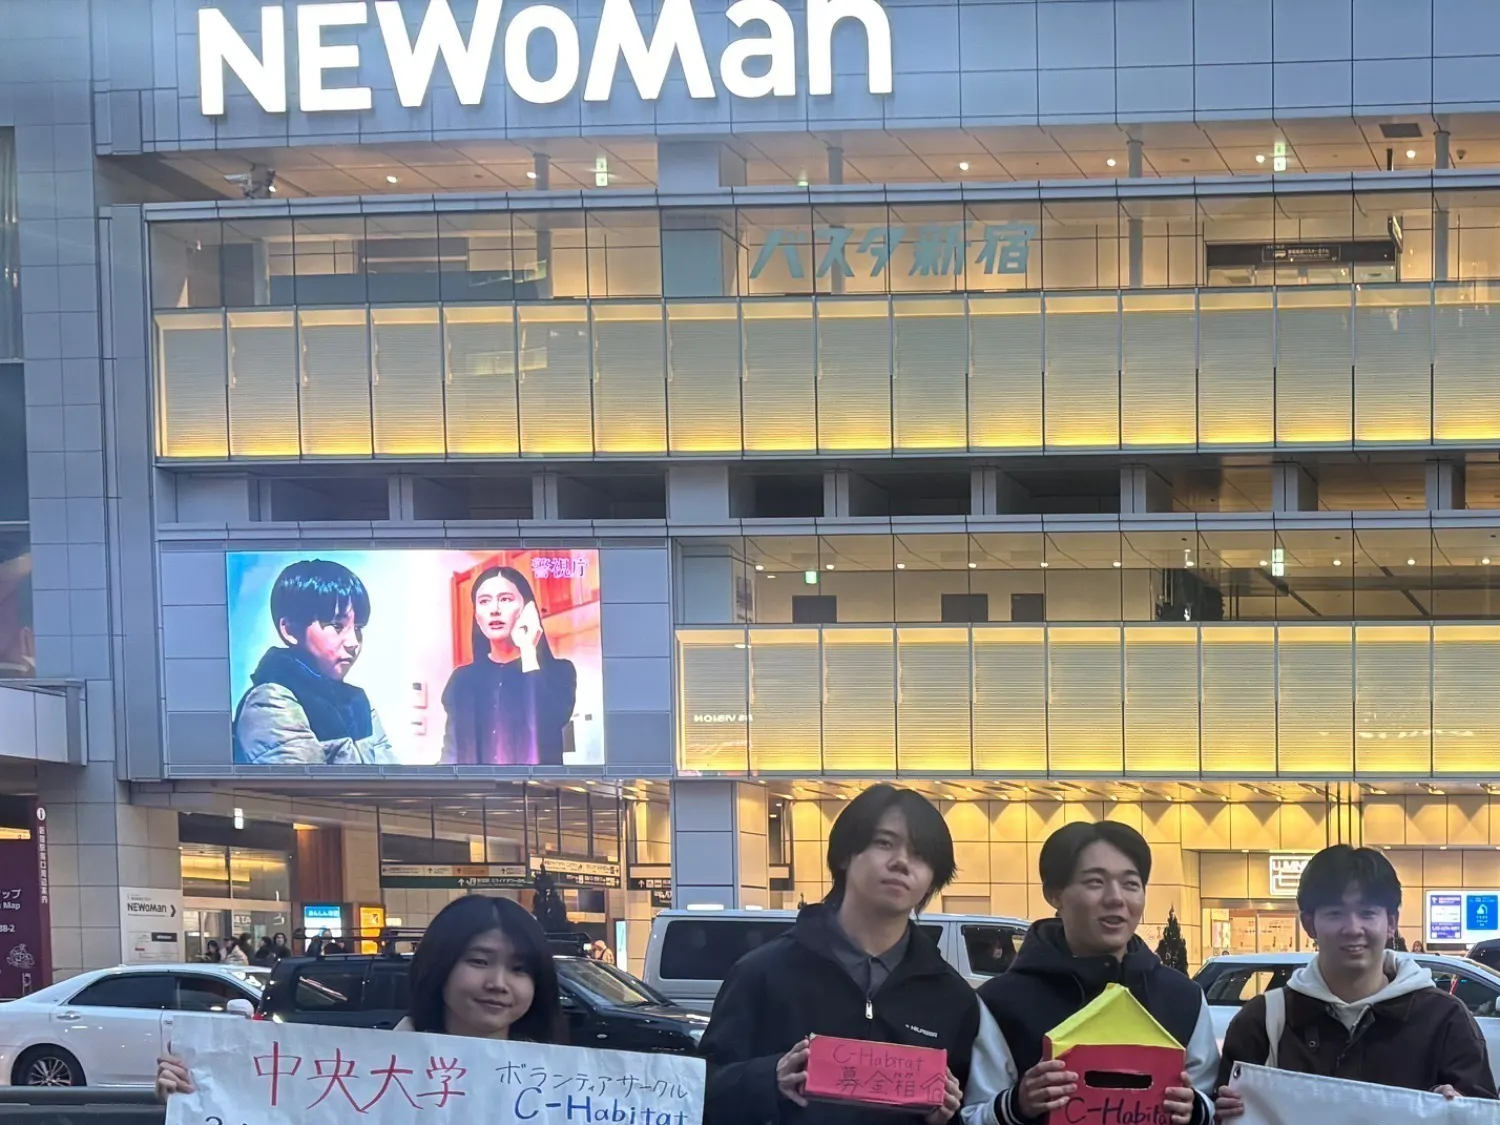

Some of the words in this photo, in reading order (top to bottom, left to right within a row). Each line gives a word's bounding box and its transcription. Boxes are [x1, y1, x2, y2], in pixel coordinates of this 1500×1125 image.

[199, 0, 893, 115] NEWoMan
[749, 221, 1037, 278] バスタ新宿
[252, 1041, 468, 1114] 中央大学
[836, 1066, 915, 1099] 募金箱
